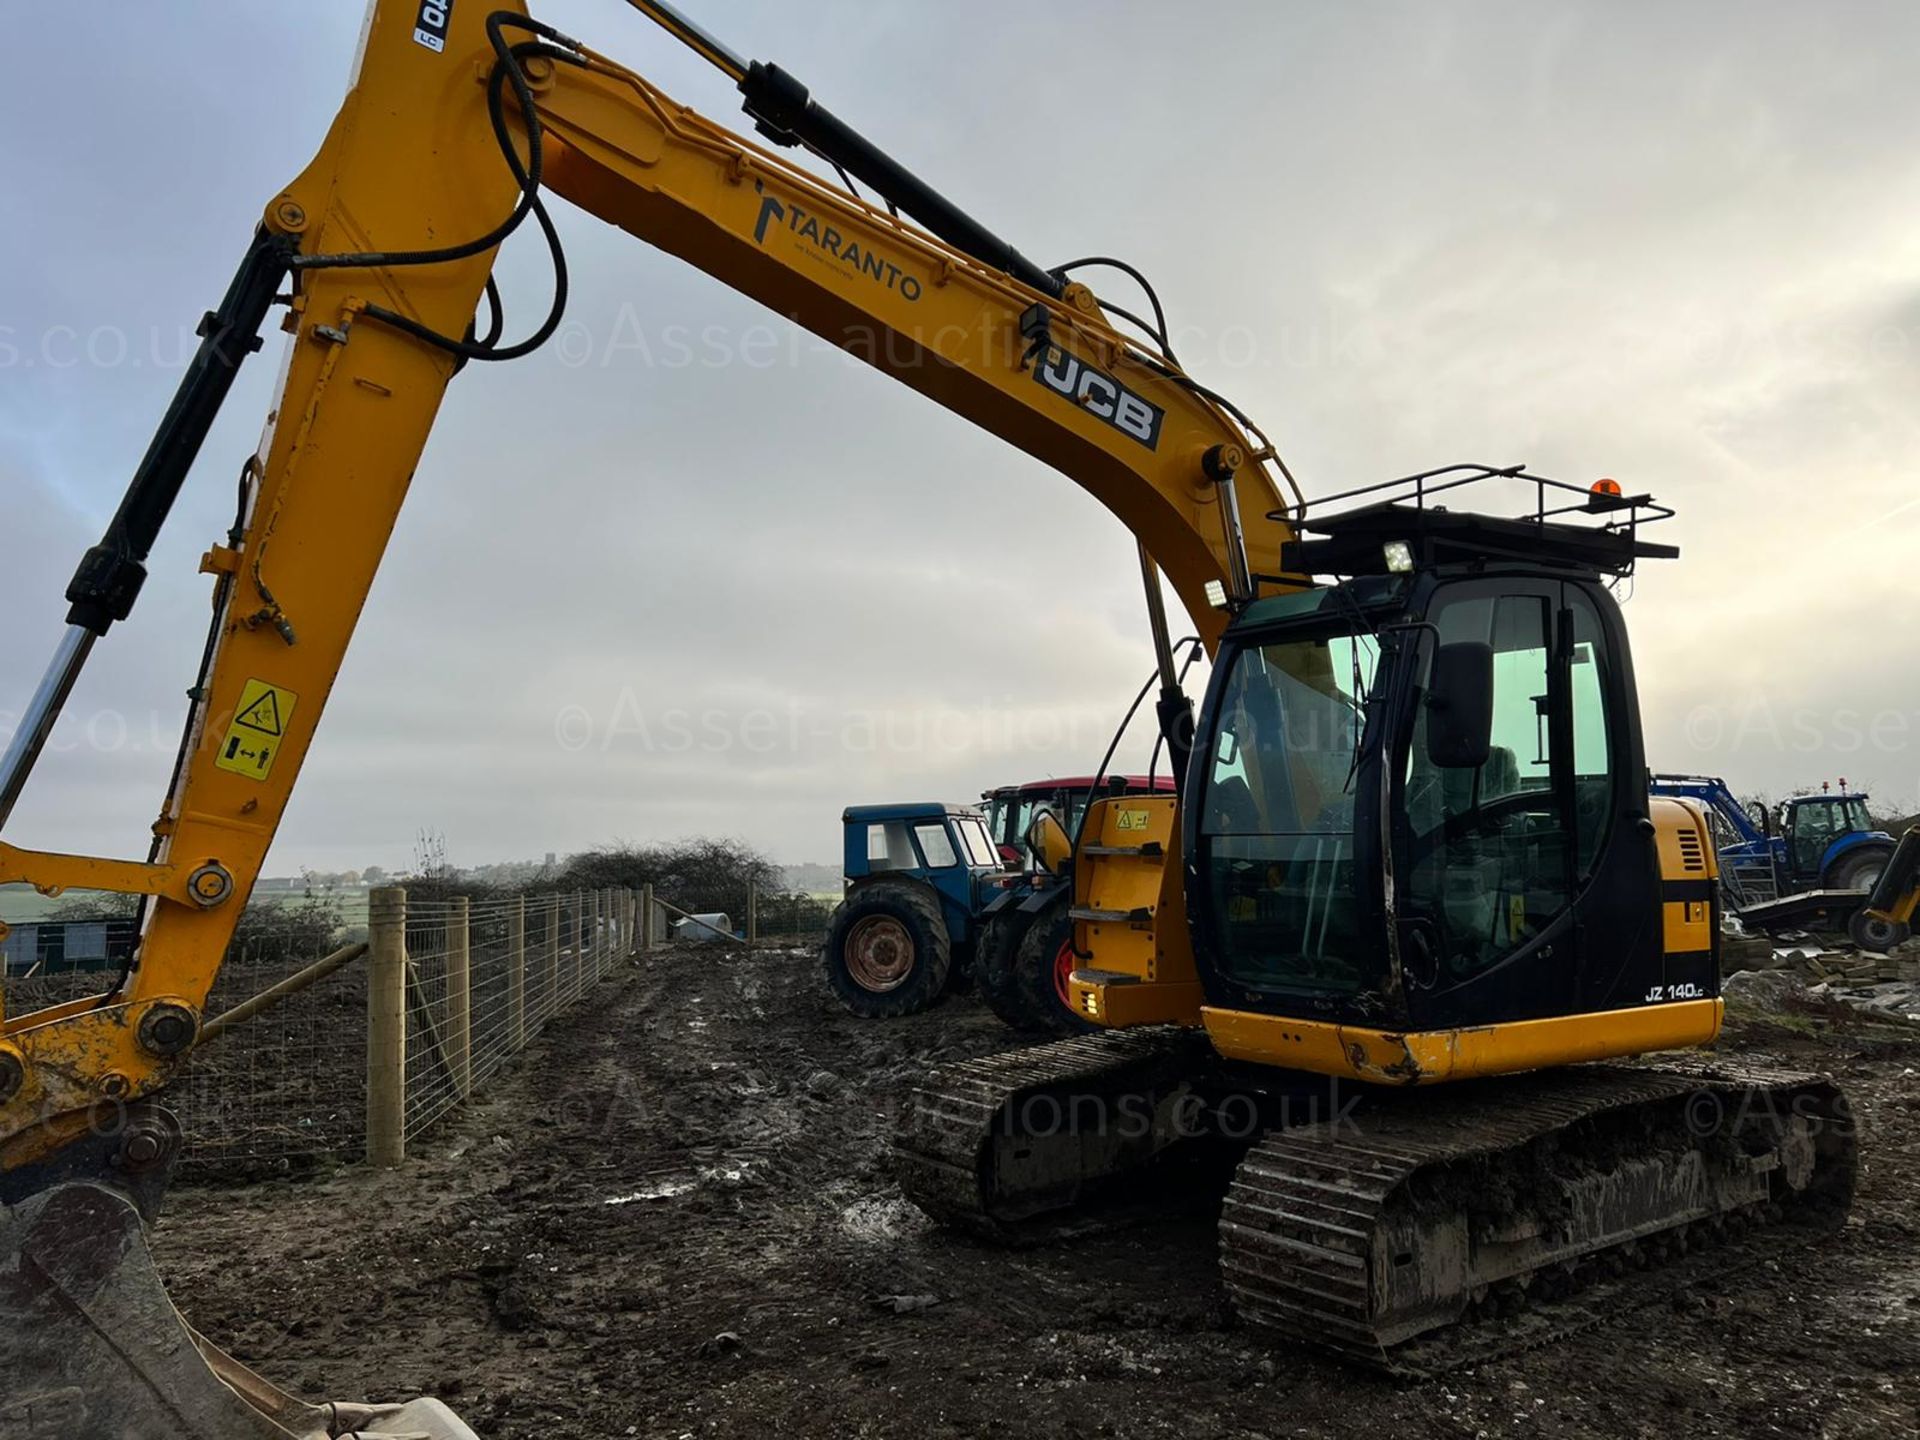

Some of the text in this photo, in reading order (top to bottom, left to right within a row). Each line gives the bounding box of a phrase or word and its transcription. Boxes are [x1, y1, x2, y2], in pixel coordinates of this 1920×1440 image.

[420, 33, 437, 47] LC
[788, 204, 922, 301] TARANTO
[1043, 359, 1154, 441] JCB
[1645, 986, 1663, 1002] JZ
